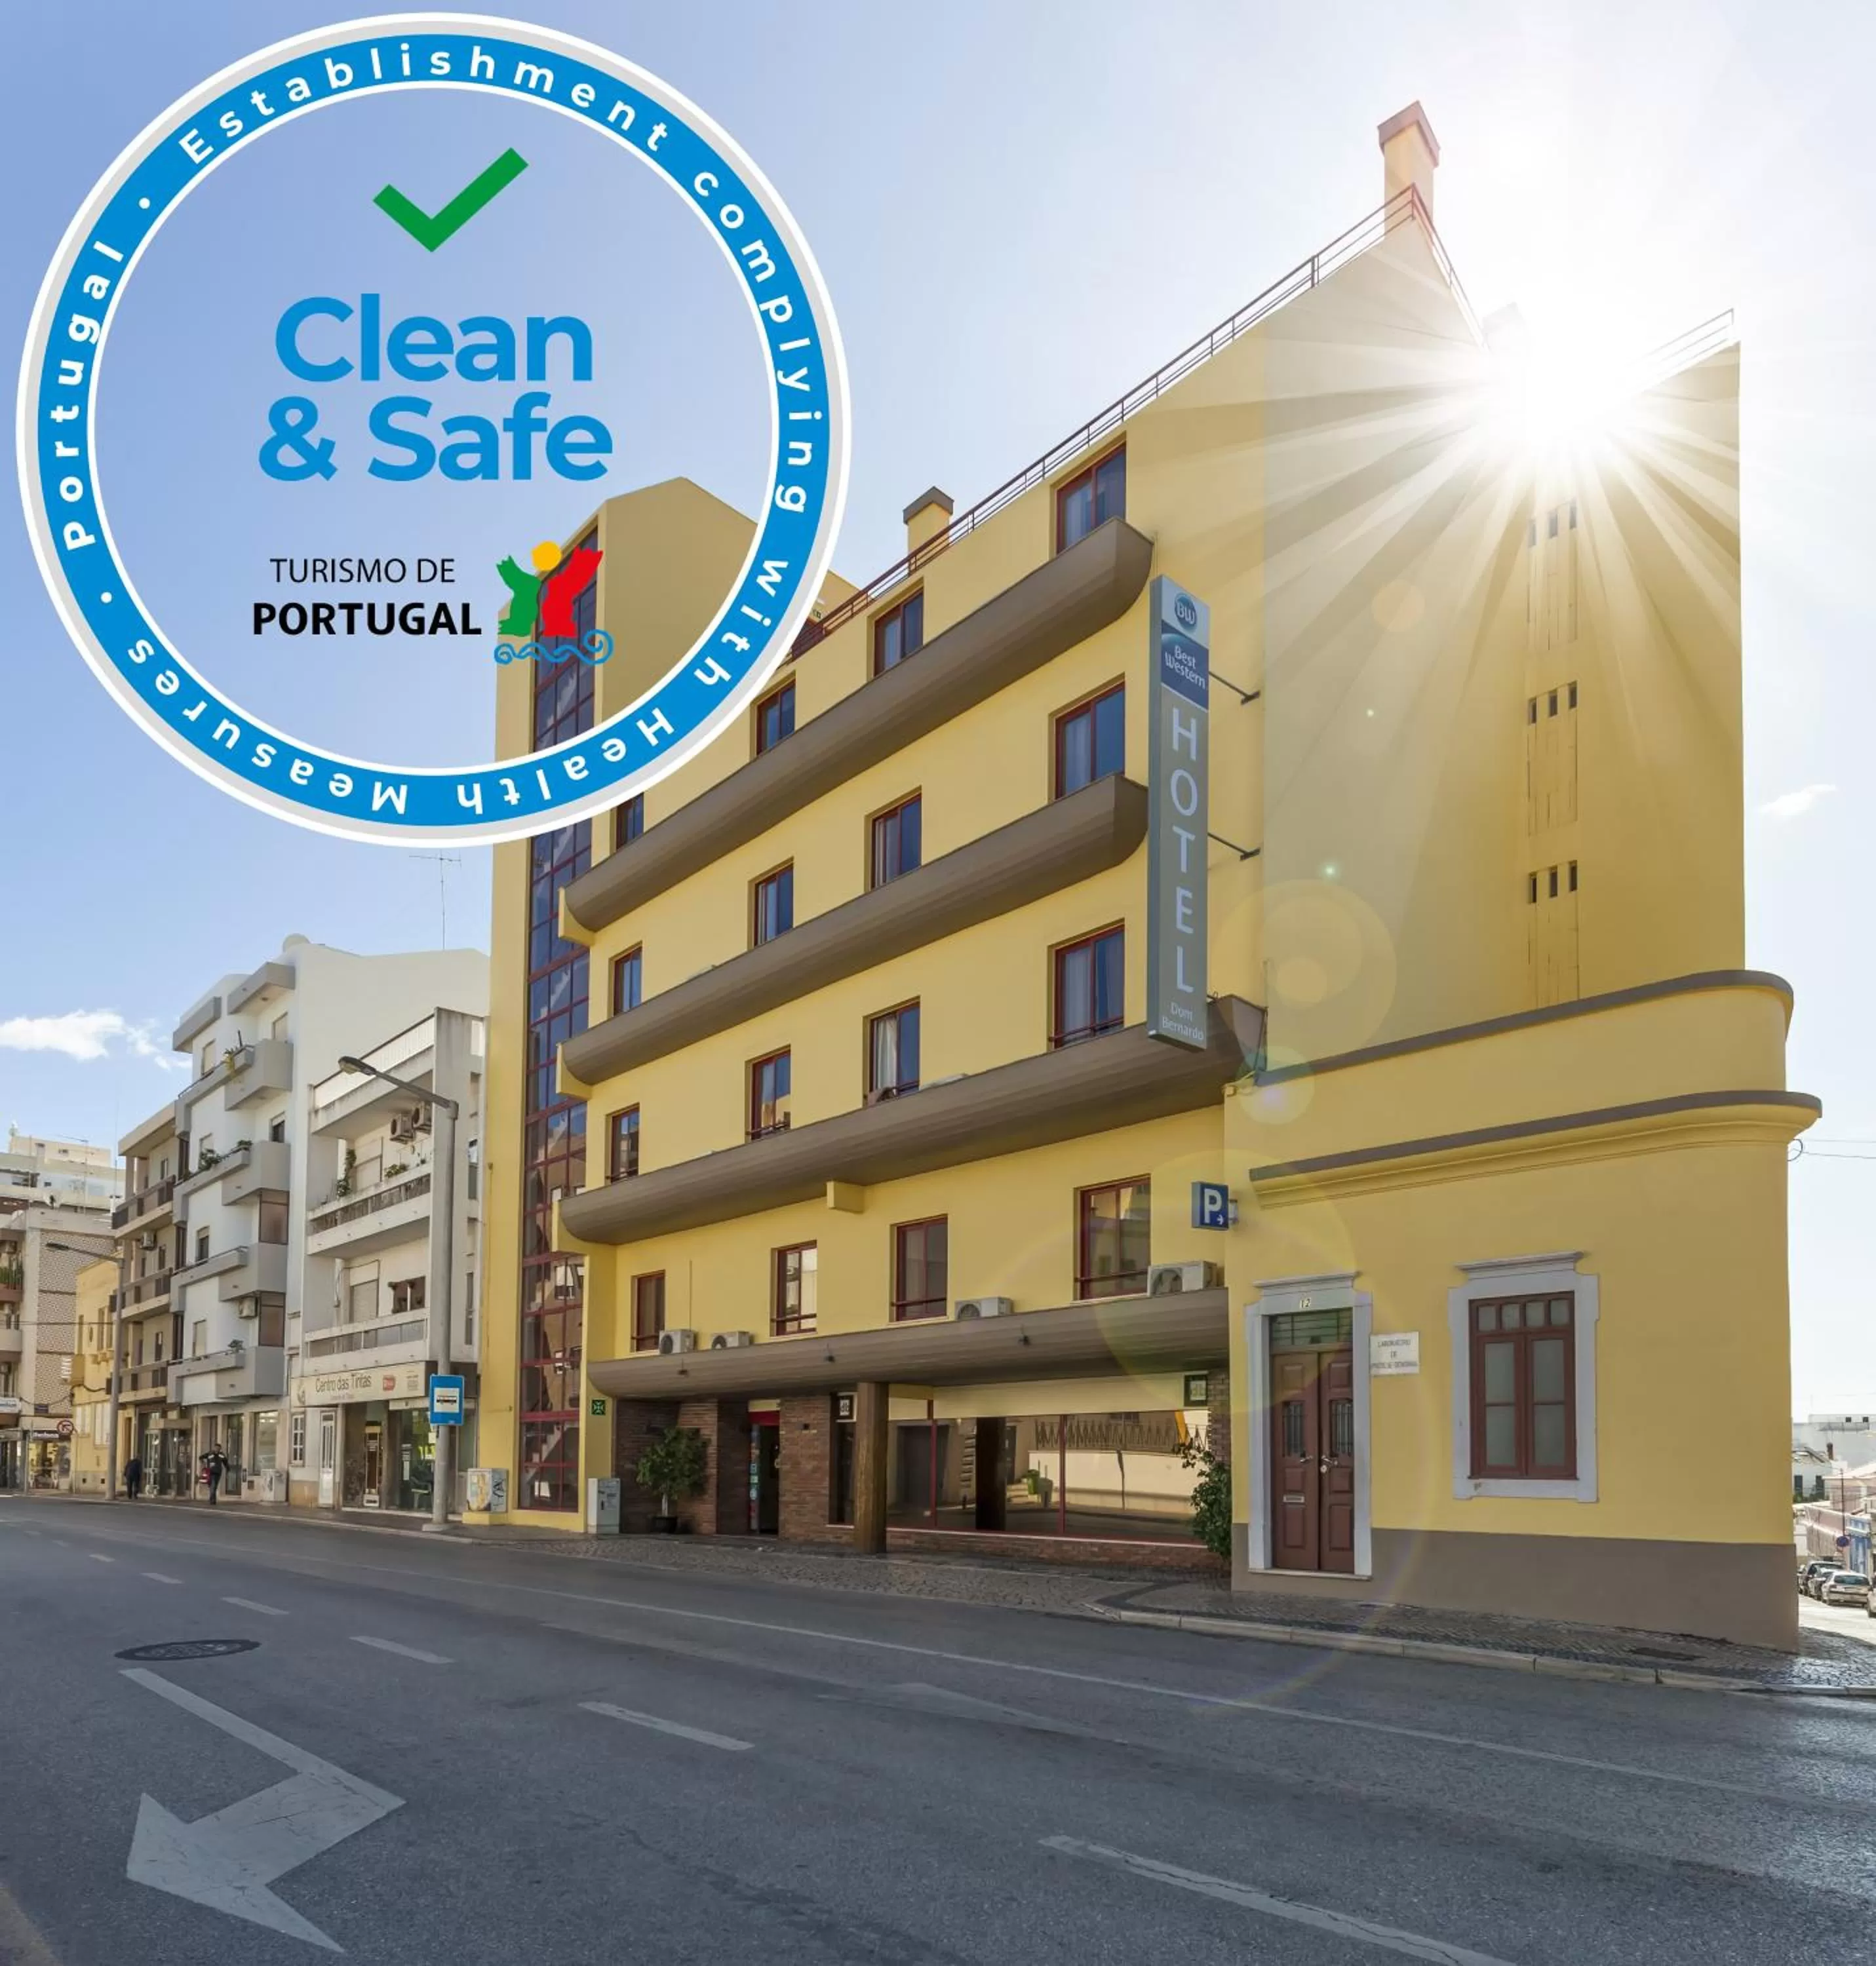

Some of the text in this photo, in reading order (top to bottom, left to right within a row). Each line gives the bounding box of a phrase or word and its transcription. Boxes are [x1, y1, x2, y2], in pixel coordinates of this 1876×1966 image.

[1176, 600, 1196, 625] BW
[1174, 645, 1196, 669] Best
[1165, 652, 1205, 689] Western
[1170, 707, 1198, 993] HOTEL
[1171, 1001, 1193, 1022] Dom
[1162, 1016, 1204, 1041] Bernardo
[1204, 1188, 1222, 1224] P
[1301, 1298, 1311, 1309] 12
[315, 1377, 336, 1393] Centro
[337, 1376, 349, 1390] das
[351, 1374, 372, 1389] Tintas
